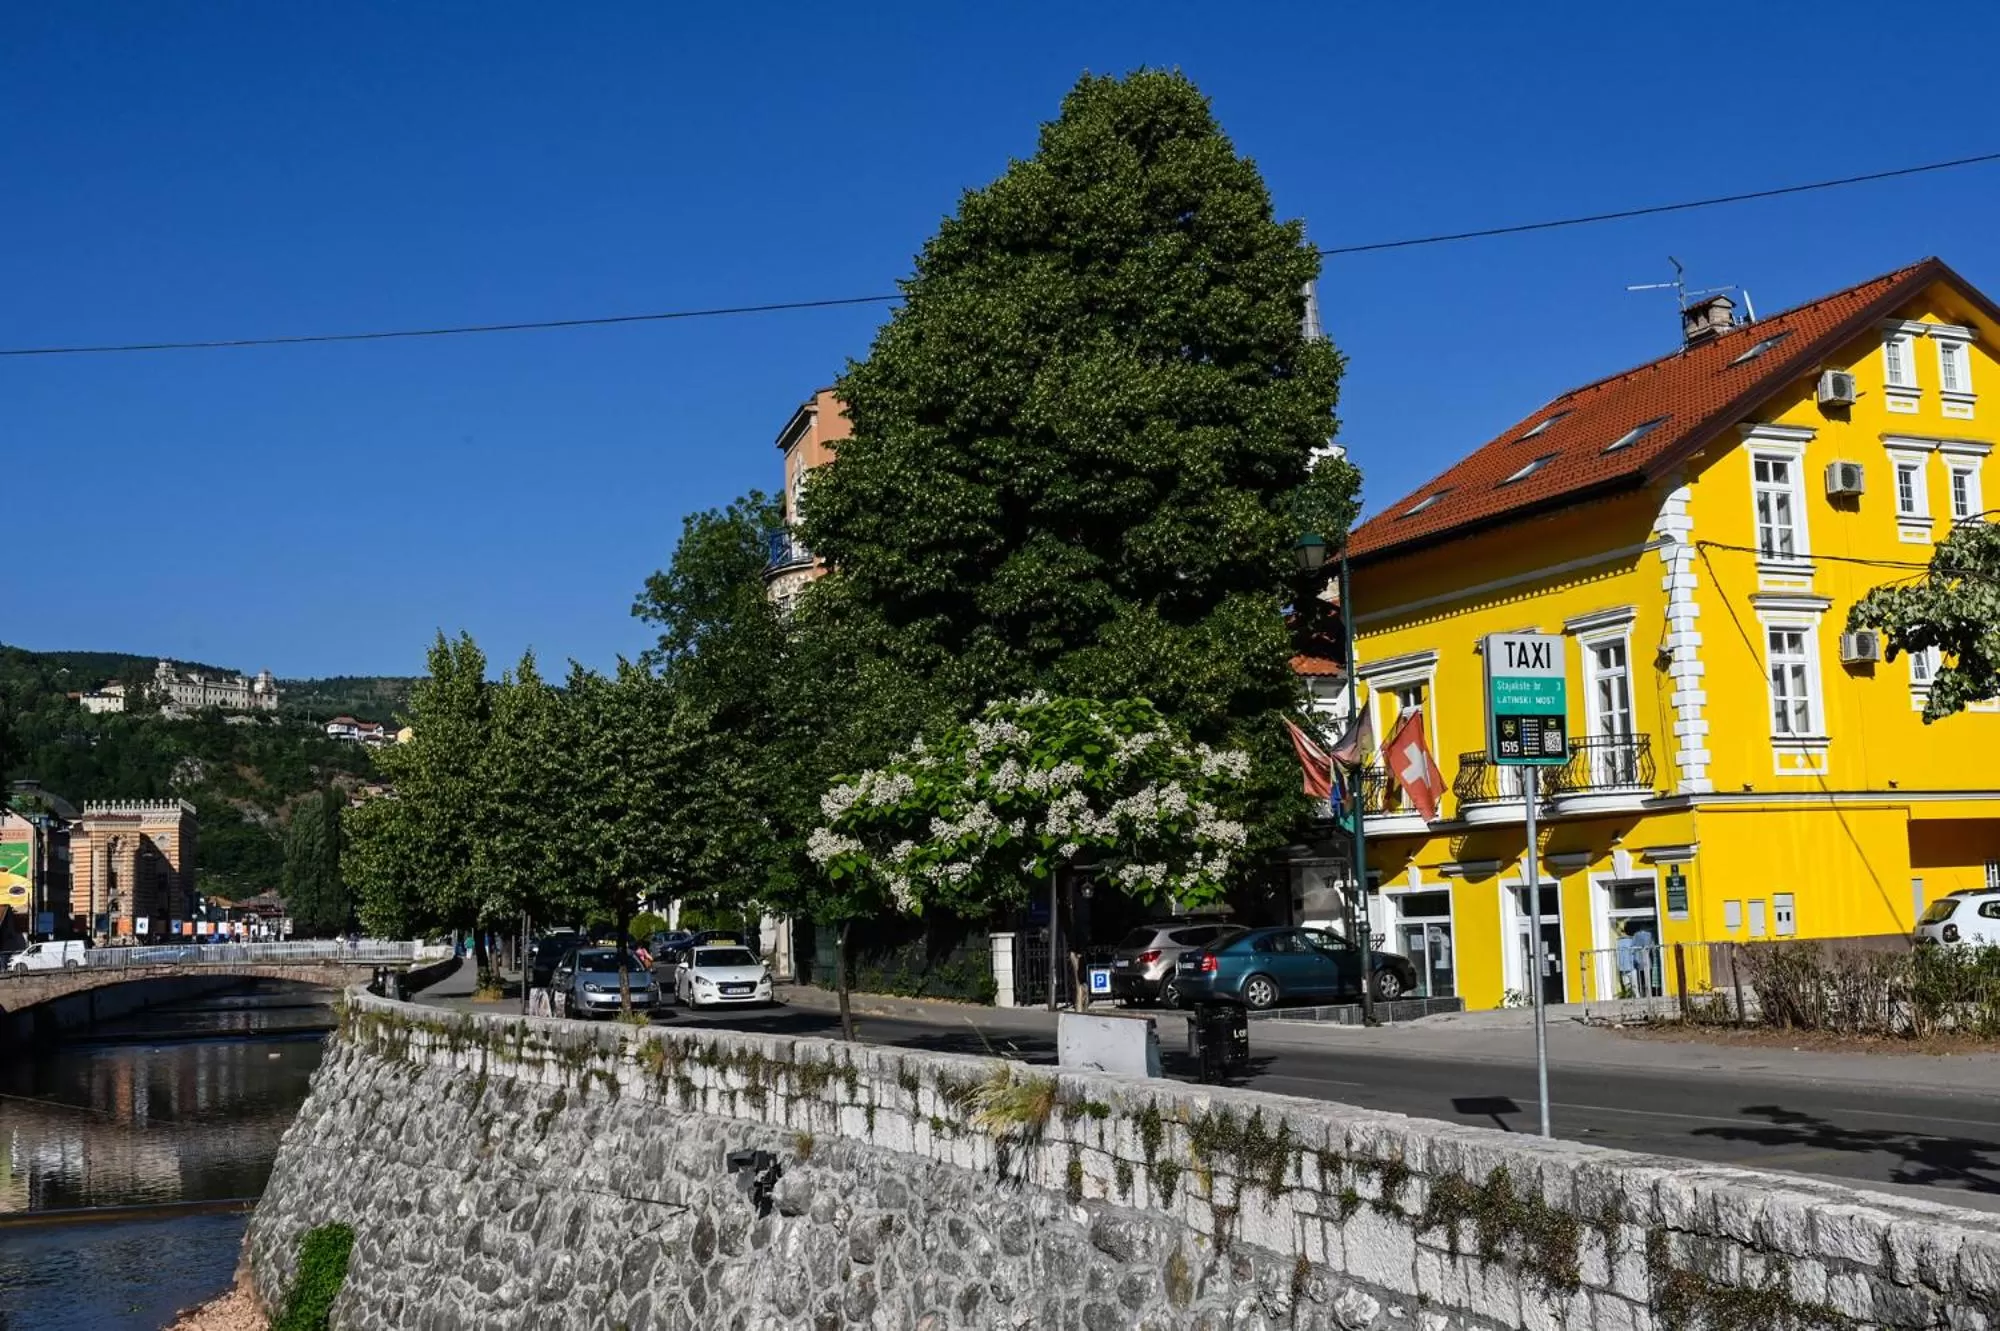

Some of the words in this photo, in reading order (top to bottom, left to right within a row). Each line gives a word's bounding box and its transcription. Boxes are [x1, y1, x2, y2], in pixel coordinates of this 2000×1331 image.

[1503, 641, 1551, 669] TAXI
[1496, 695, 1532, 704] LATINSKI
[1535, 696, 1555, 705] MOST
[1501, 740, 1519, 753] 1515
